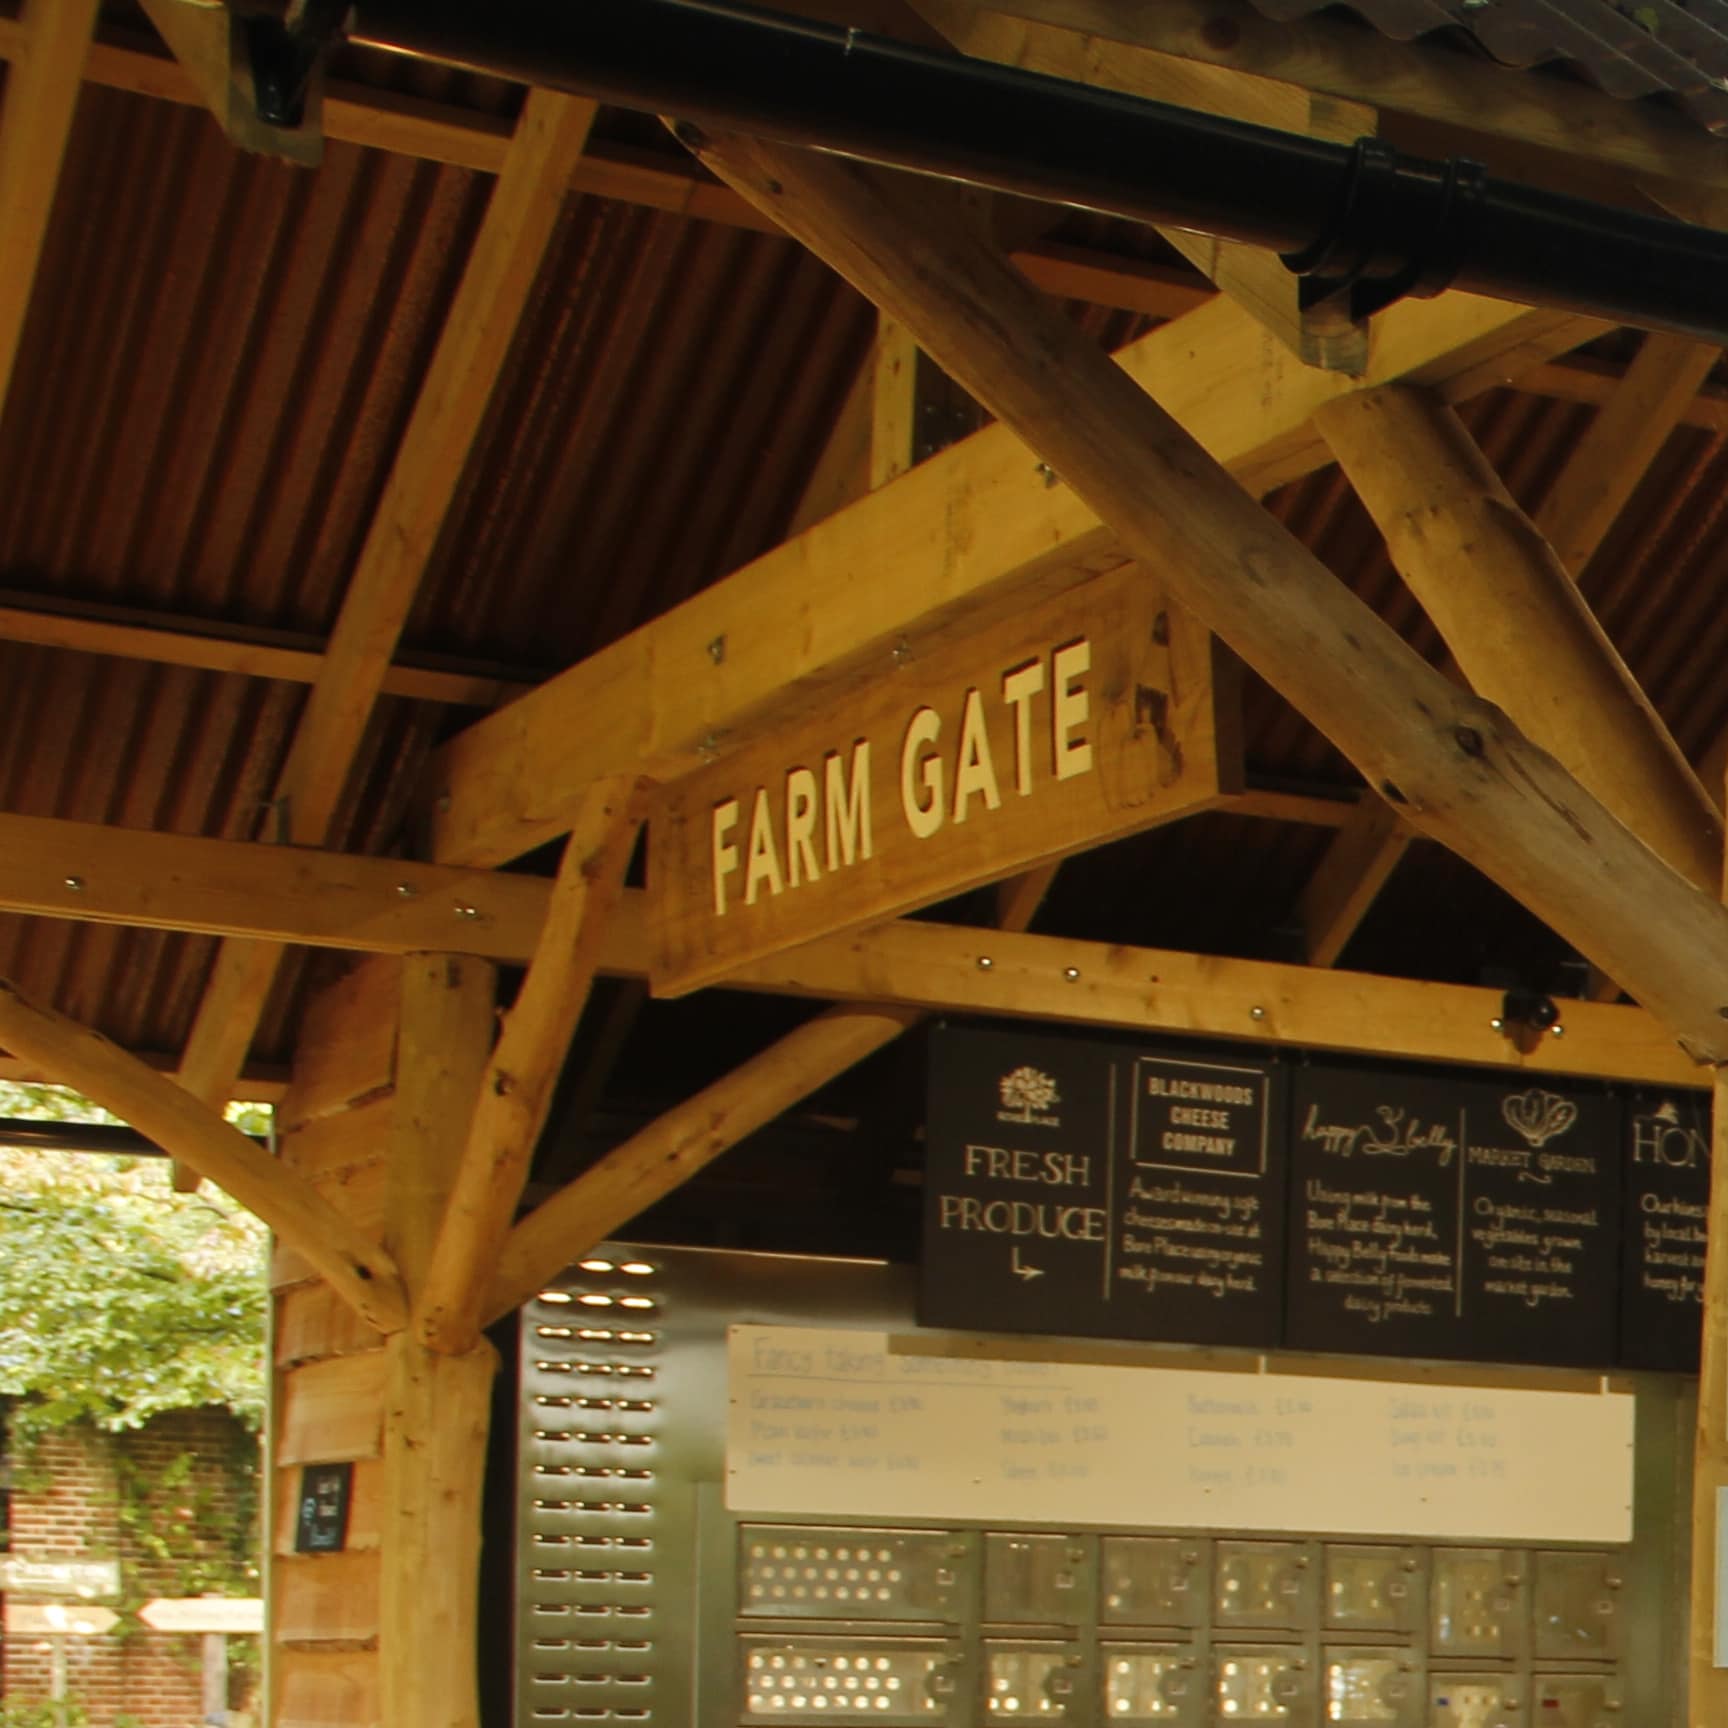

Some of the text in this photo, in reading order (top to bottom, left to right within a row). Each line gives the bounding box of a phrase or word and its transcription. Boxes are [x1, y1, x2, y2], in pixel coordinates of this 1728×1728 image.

[711, 636, 1094, 916] FARM GATE
[1148, 1076, 1254, 1107] BLACKWOODS
[1170, 1106, 1231, 1131] CHEESE
[1163, 1131, 1237, 1157] COMPANY
[966, 1144, 1092, 1188] FRESH
[1468, 1146, 1597, 1175] MARKET GARDEN
[940, 1195, 1108, 1242] PRODUCE
